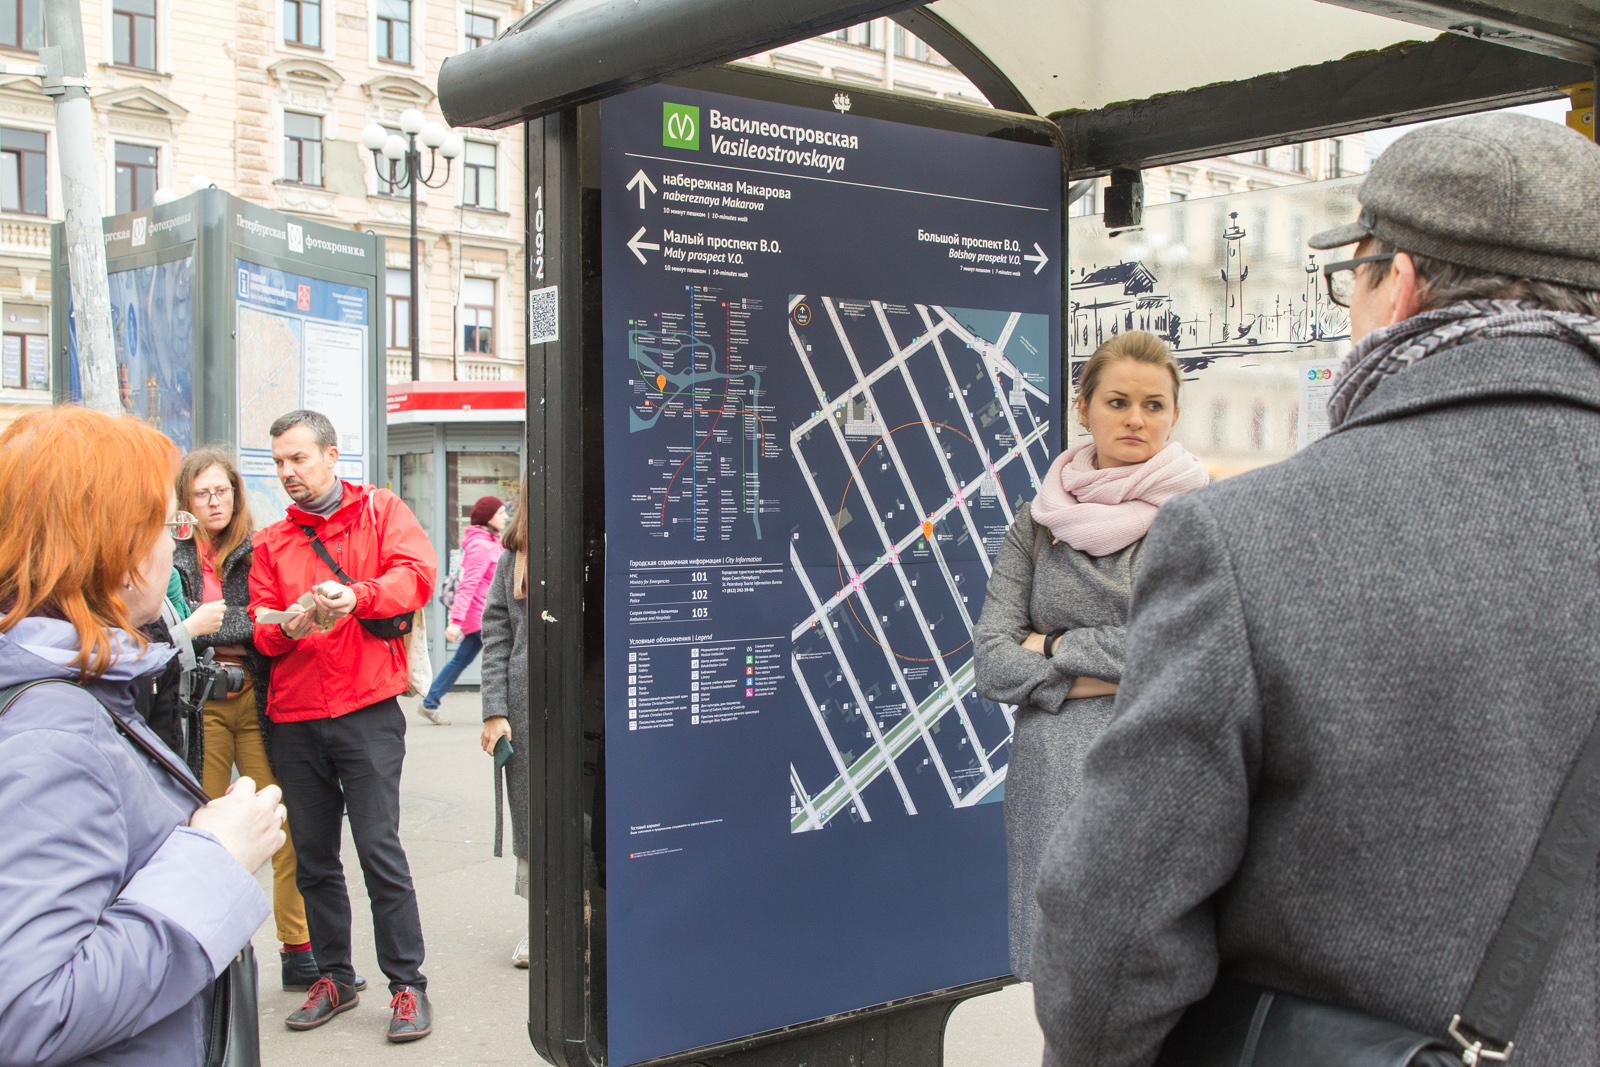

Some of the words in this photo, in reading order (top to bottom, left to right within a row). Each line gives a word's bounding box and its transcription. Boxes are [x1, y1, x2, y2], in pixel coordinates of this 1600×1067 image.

[710, 109, 859, 149] Василеостровская
[711, 134, 846, 173] Vasileostrovskaya
[663, 174, 733, 192] набережная
[736, 181, 791, 199] Макарова
[663, 191, 720, 207] nabereznaya
[722, 196, 764, 211] Makarova
[686, 210, 706, 218] пешком
[711, 212, 737, 221] 10-minutes
[148, 212, 191, 236] фотохроника
[534, 186, 544, 279] 1092
[236, 213, 286, 240] Петербургская
[305, 234, 365, 257] фотохроника
[663, 229, 704, 246] Малый
[707, 237, 758, 252] проспект
[760, 239, 782, 254] В.О.
[917, 228, 960, 245] Большой
[961, 236, 1003, 250] проспект
[1003, 239, 1022, 252] В.О.
[664, 246, 687, 261] Maly
[687, 251, 726, 263] prospect
[727, 252, 744, 265] V.O.
[948, 248, 977, 263] Bolshoy
[976, 252, 1008, 264] prospekt
[1008, 254, 1022, 265] V.O.
[671, 266, 687, 274] минут
[712, 268, 738, 277] 10-minutes
[629, 559, 657, 567] Городская
[657, 558, 688, 567] справочная
[689, 557, 722, 566] информация
[725, 556, 735, 564] City
[735, 555, 762, 564] Information
[691, 571, 708, 582] 101
[691, 589, 708, 600] 102
[691, 607, 708, 618] 103
[695, 633, 713, 642] Legend
